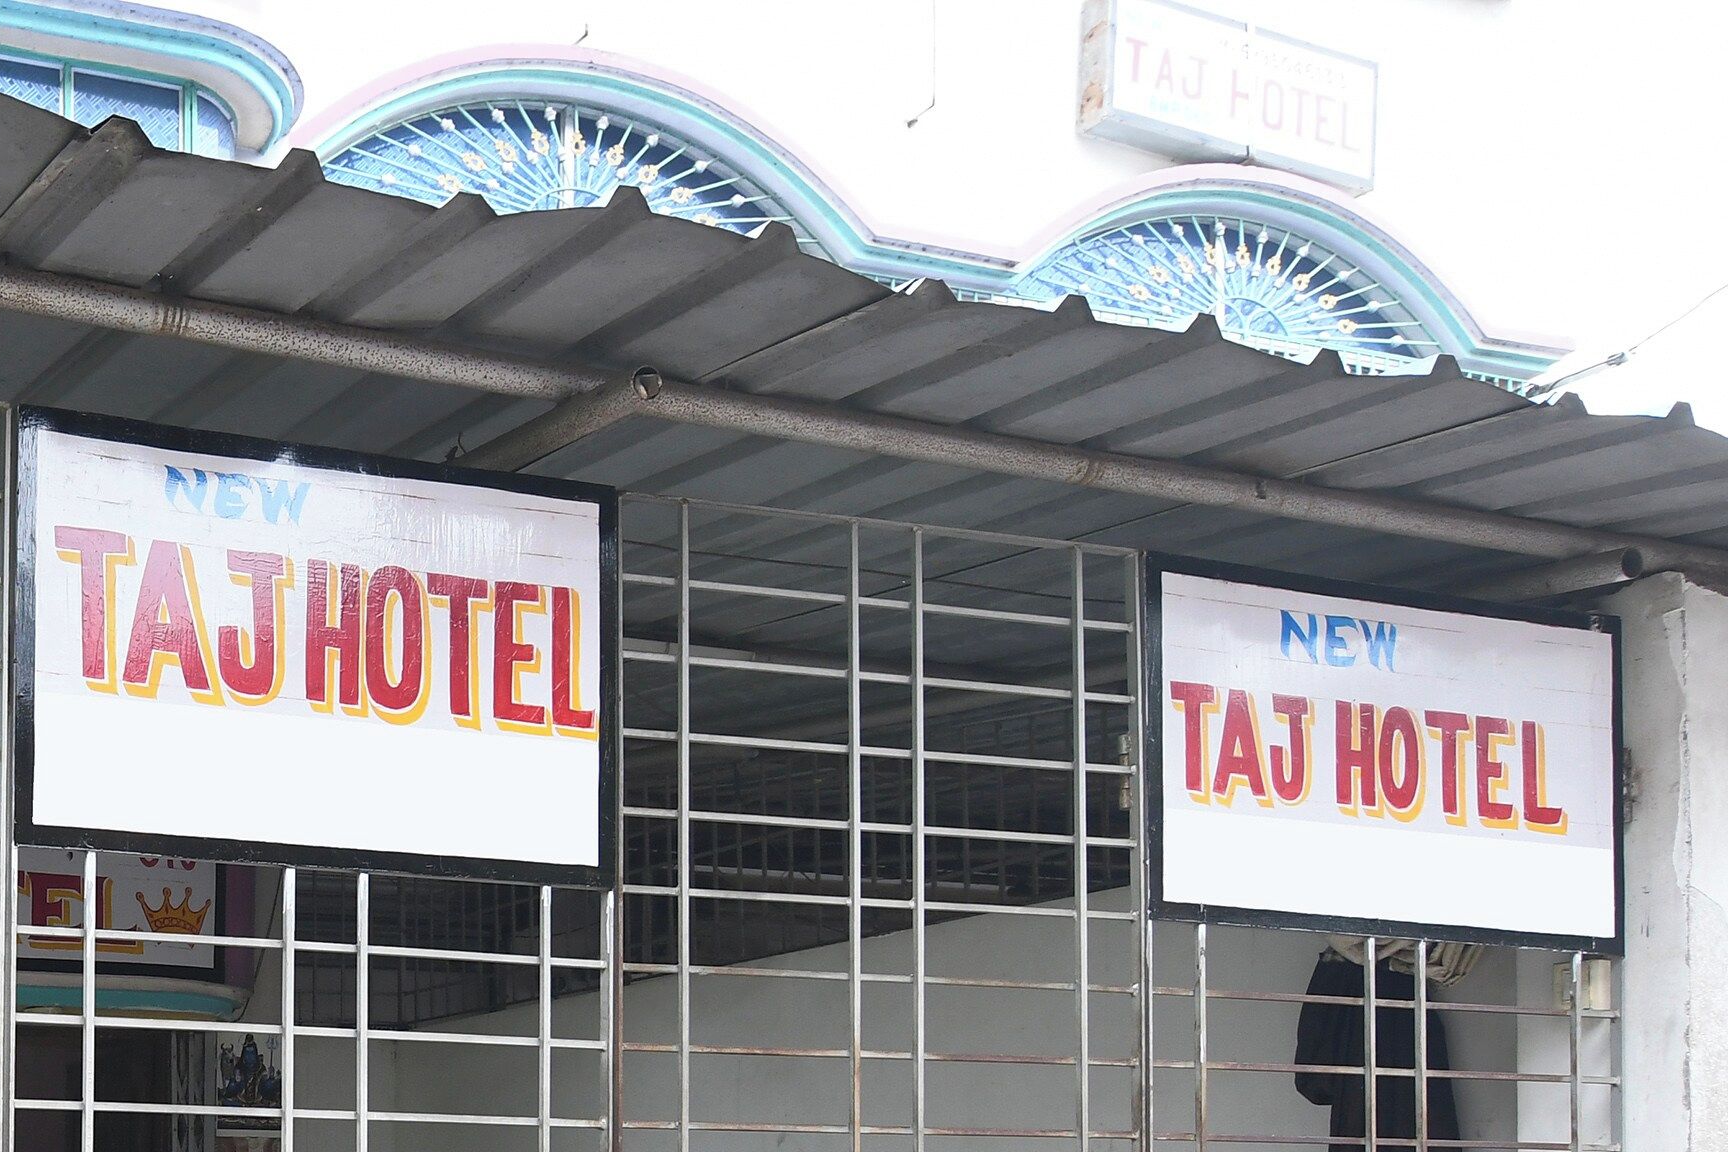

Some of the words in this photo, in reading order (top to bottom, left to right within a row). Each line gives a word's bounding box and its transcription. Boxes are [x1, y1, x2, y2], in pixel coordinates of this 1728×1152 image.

[1125, 35, 1208, 101] TAJ
[164, 463, 312, 528] NEW
[54, 525, 294, 707] TAJ
[305, 558, 598, 742] HOTEL
[1279, 608, 1398, 673] NEW
[1170, 680, 1315, 809] TAJ
[1335, 700, 1568, 836] HOTEL
